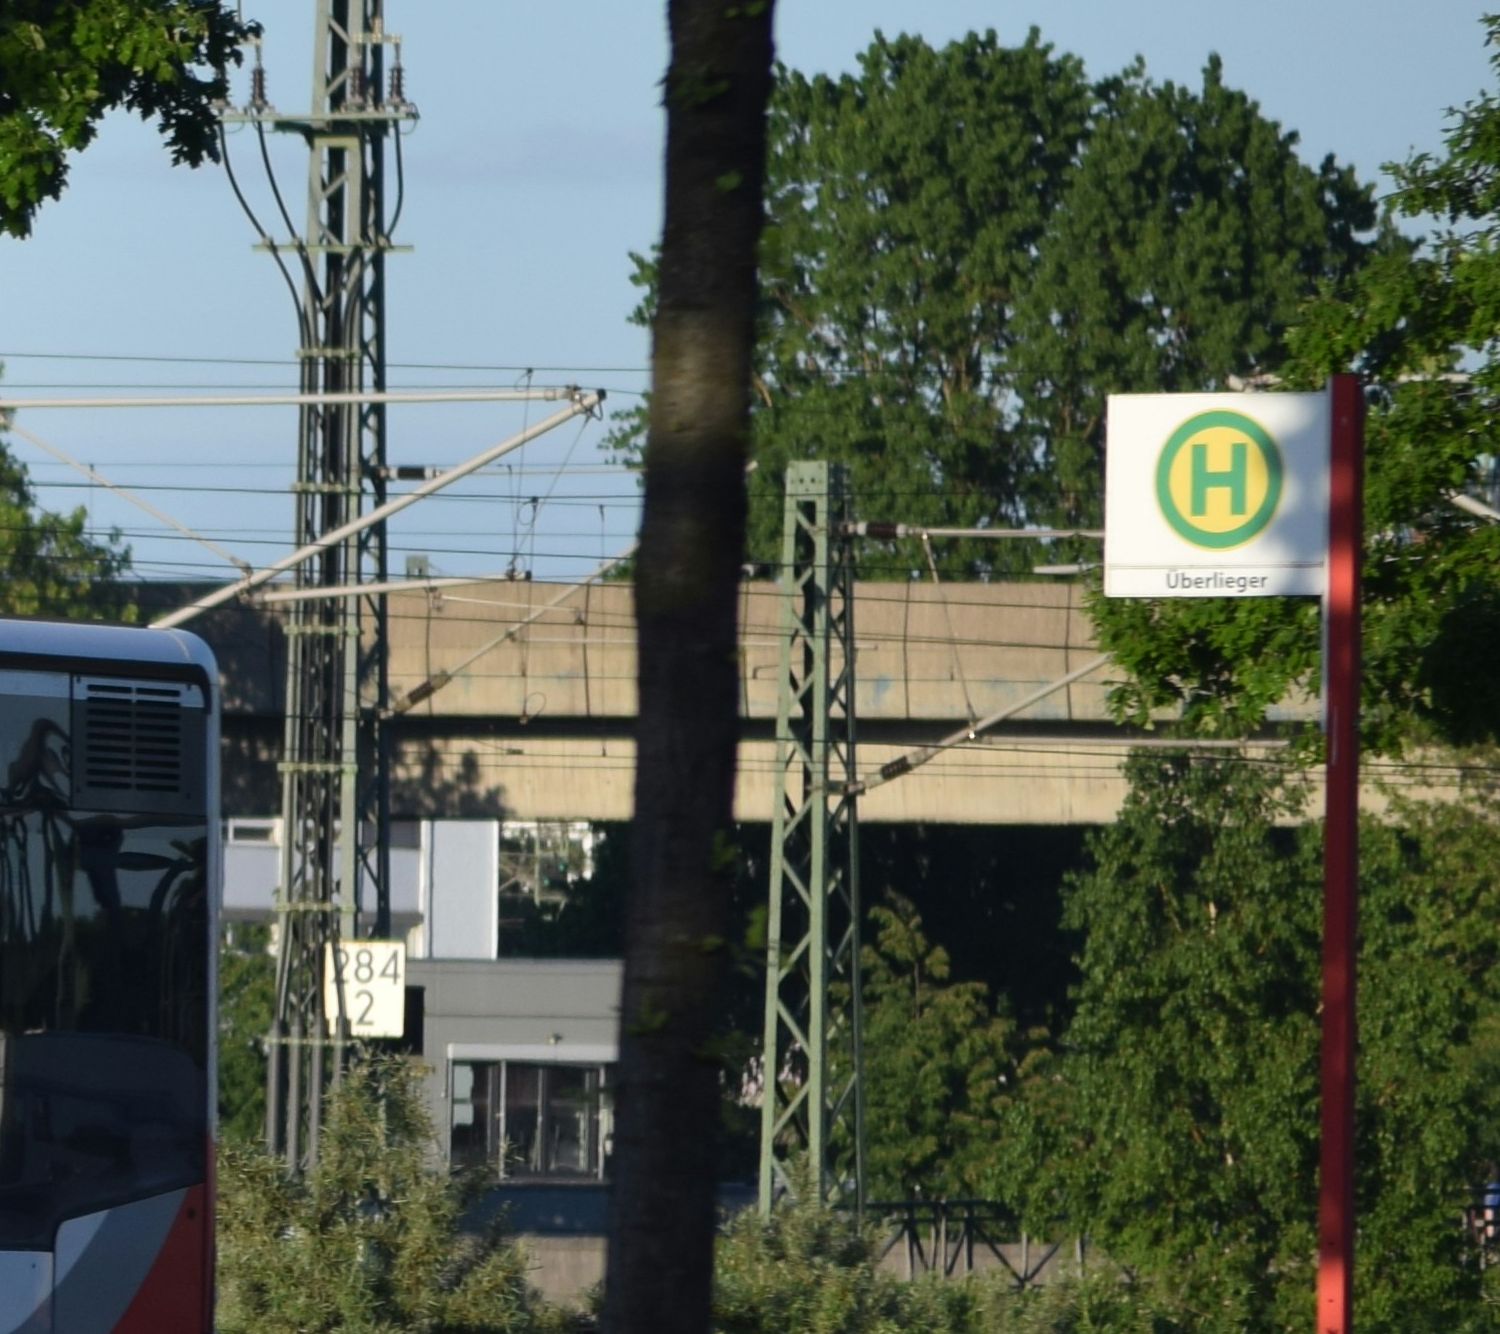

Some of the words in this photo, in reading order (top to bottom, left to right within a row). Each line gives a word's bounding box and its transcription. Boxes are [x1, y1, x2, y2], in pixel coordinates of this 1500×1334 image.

[1190, 442, 1248, 517] H
[1165, 568, 1268, 593] Überlieger
[355, 989, 375, 1026] 2
